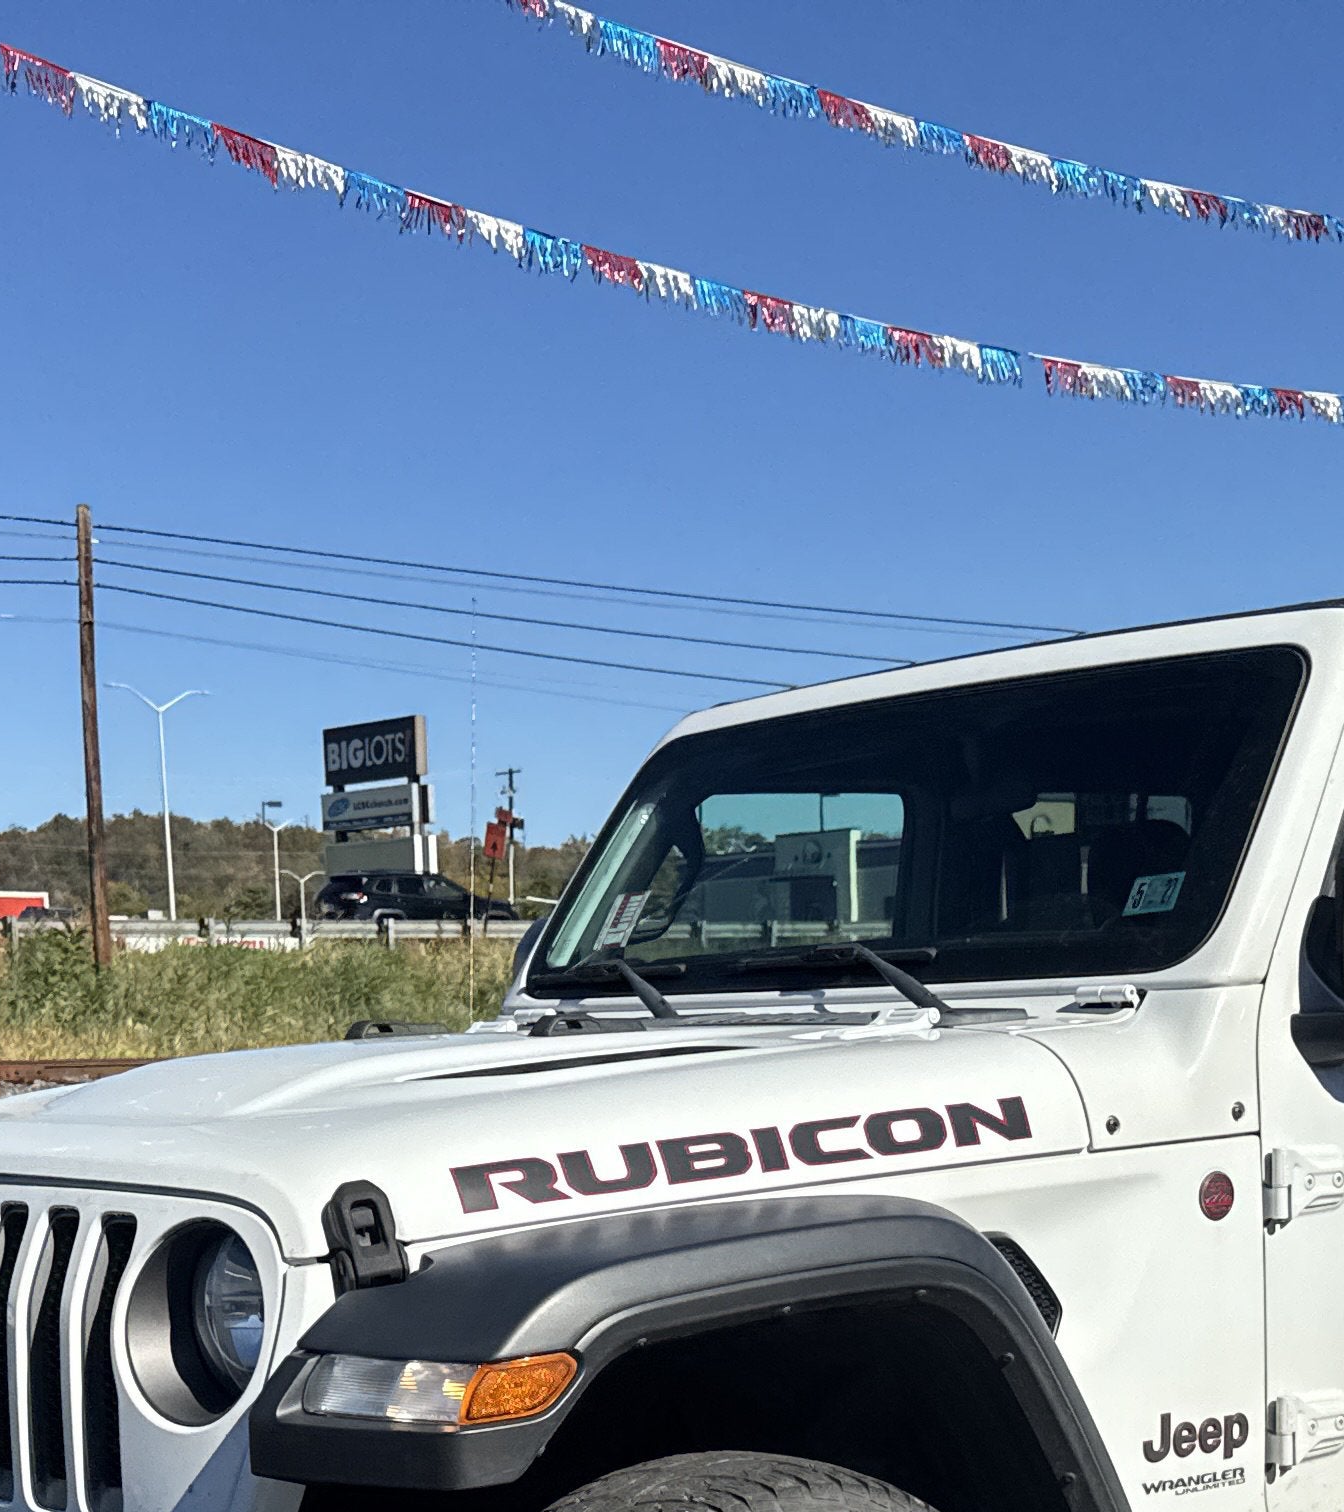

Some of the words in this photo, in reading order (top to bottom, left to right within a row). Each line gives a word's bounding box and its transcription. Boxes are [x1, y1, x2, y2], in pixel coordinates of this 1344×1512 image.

[448, 1095, 1033, 1214] RUBICON
[1142, 1412, 1249, 1463] Jeep
[1141, 1466, 1246, 1495] WRANGLER
[1174, 1477, 1246, 1496] UNLIMITED
